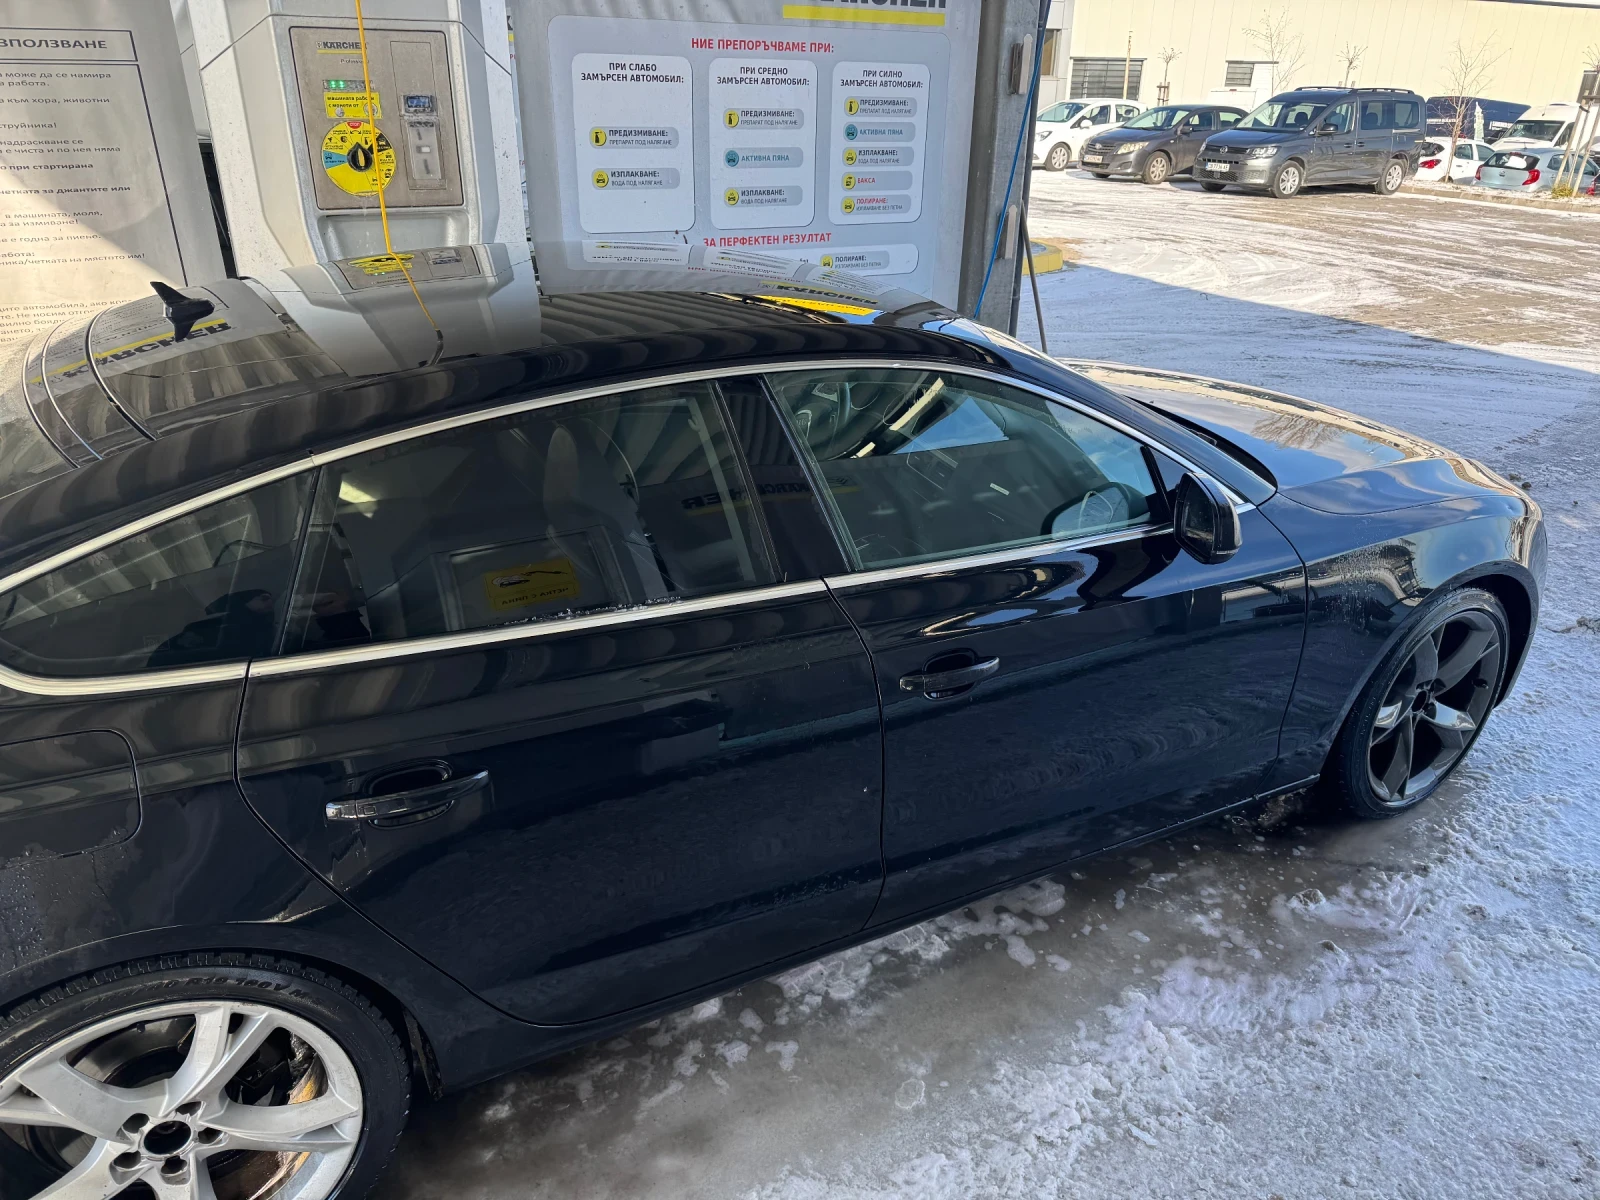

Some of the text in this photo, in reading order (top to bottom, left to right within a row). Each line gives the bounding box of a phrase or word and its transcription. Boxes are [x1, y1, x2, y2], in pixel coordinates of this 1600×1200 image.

[691, 37, 835, 53] НИЕ ПРЕПОРЪЧВАМЕ ПРИ:
[608, 62, 657, 72] ПРИ СЛАБО
[740, 66, 788, 76] ПРИ СРЕДНО
[580, 73, 684, 83] ЗАМЪРСЕН АВТОМОБИЛ:
[862, 69, 903, 78] ПРИ СИЛНО
[717, 76, 810, 86] ЗАМЪРСЕН АВТОМОБИЛ:
[840, 79, 924, 89] ЗАМЪРСЕН АВТОМОБИЛ:
[859, 99, 909, 107] ПРЕДИЗМИВАНЕ:
[740, 110, 795, 118] ПРЕДИЗМИВАНЕ:
[608, 129, 669, 138] ПРЕДИЗМИВАНЕ:
[858, 149, 898, 157] ИЗПЛАКВАНЕ:
[741, 154, 771, 162] АКТИВНА
[32, 163, 94, 171] стартирана
[610, 170, 660, 178] ИЗПЛАКВАНЕ:
[56, 186, 108, 194] джантите
[740, 188, 785, 197] ИЗПЛАКВАНЕ:
[703, 232, 832, 248] ЗА ПЕРФЕКТЕН РЕЗУЛТАТ
